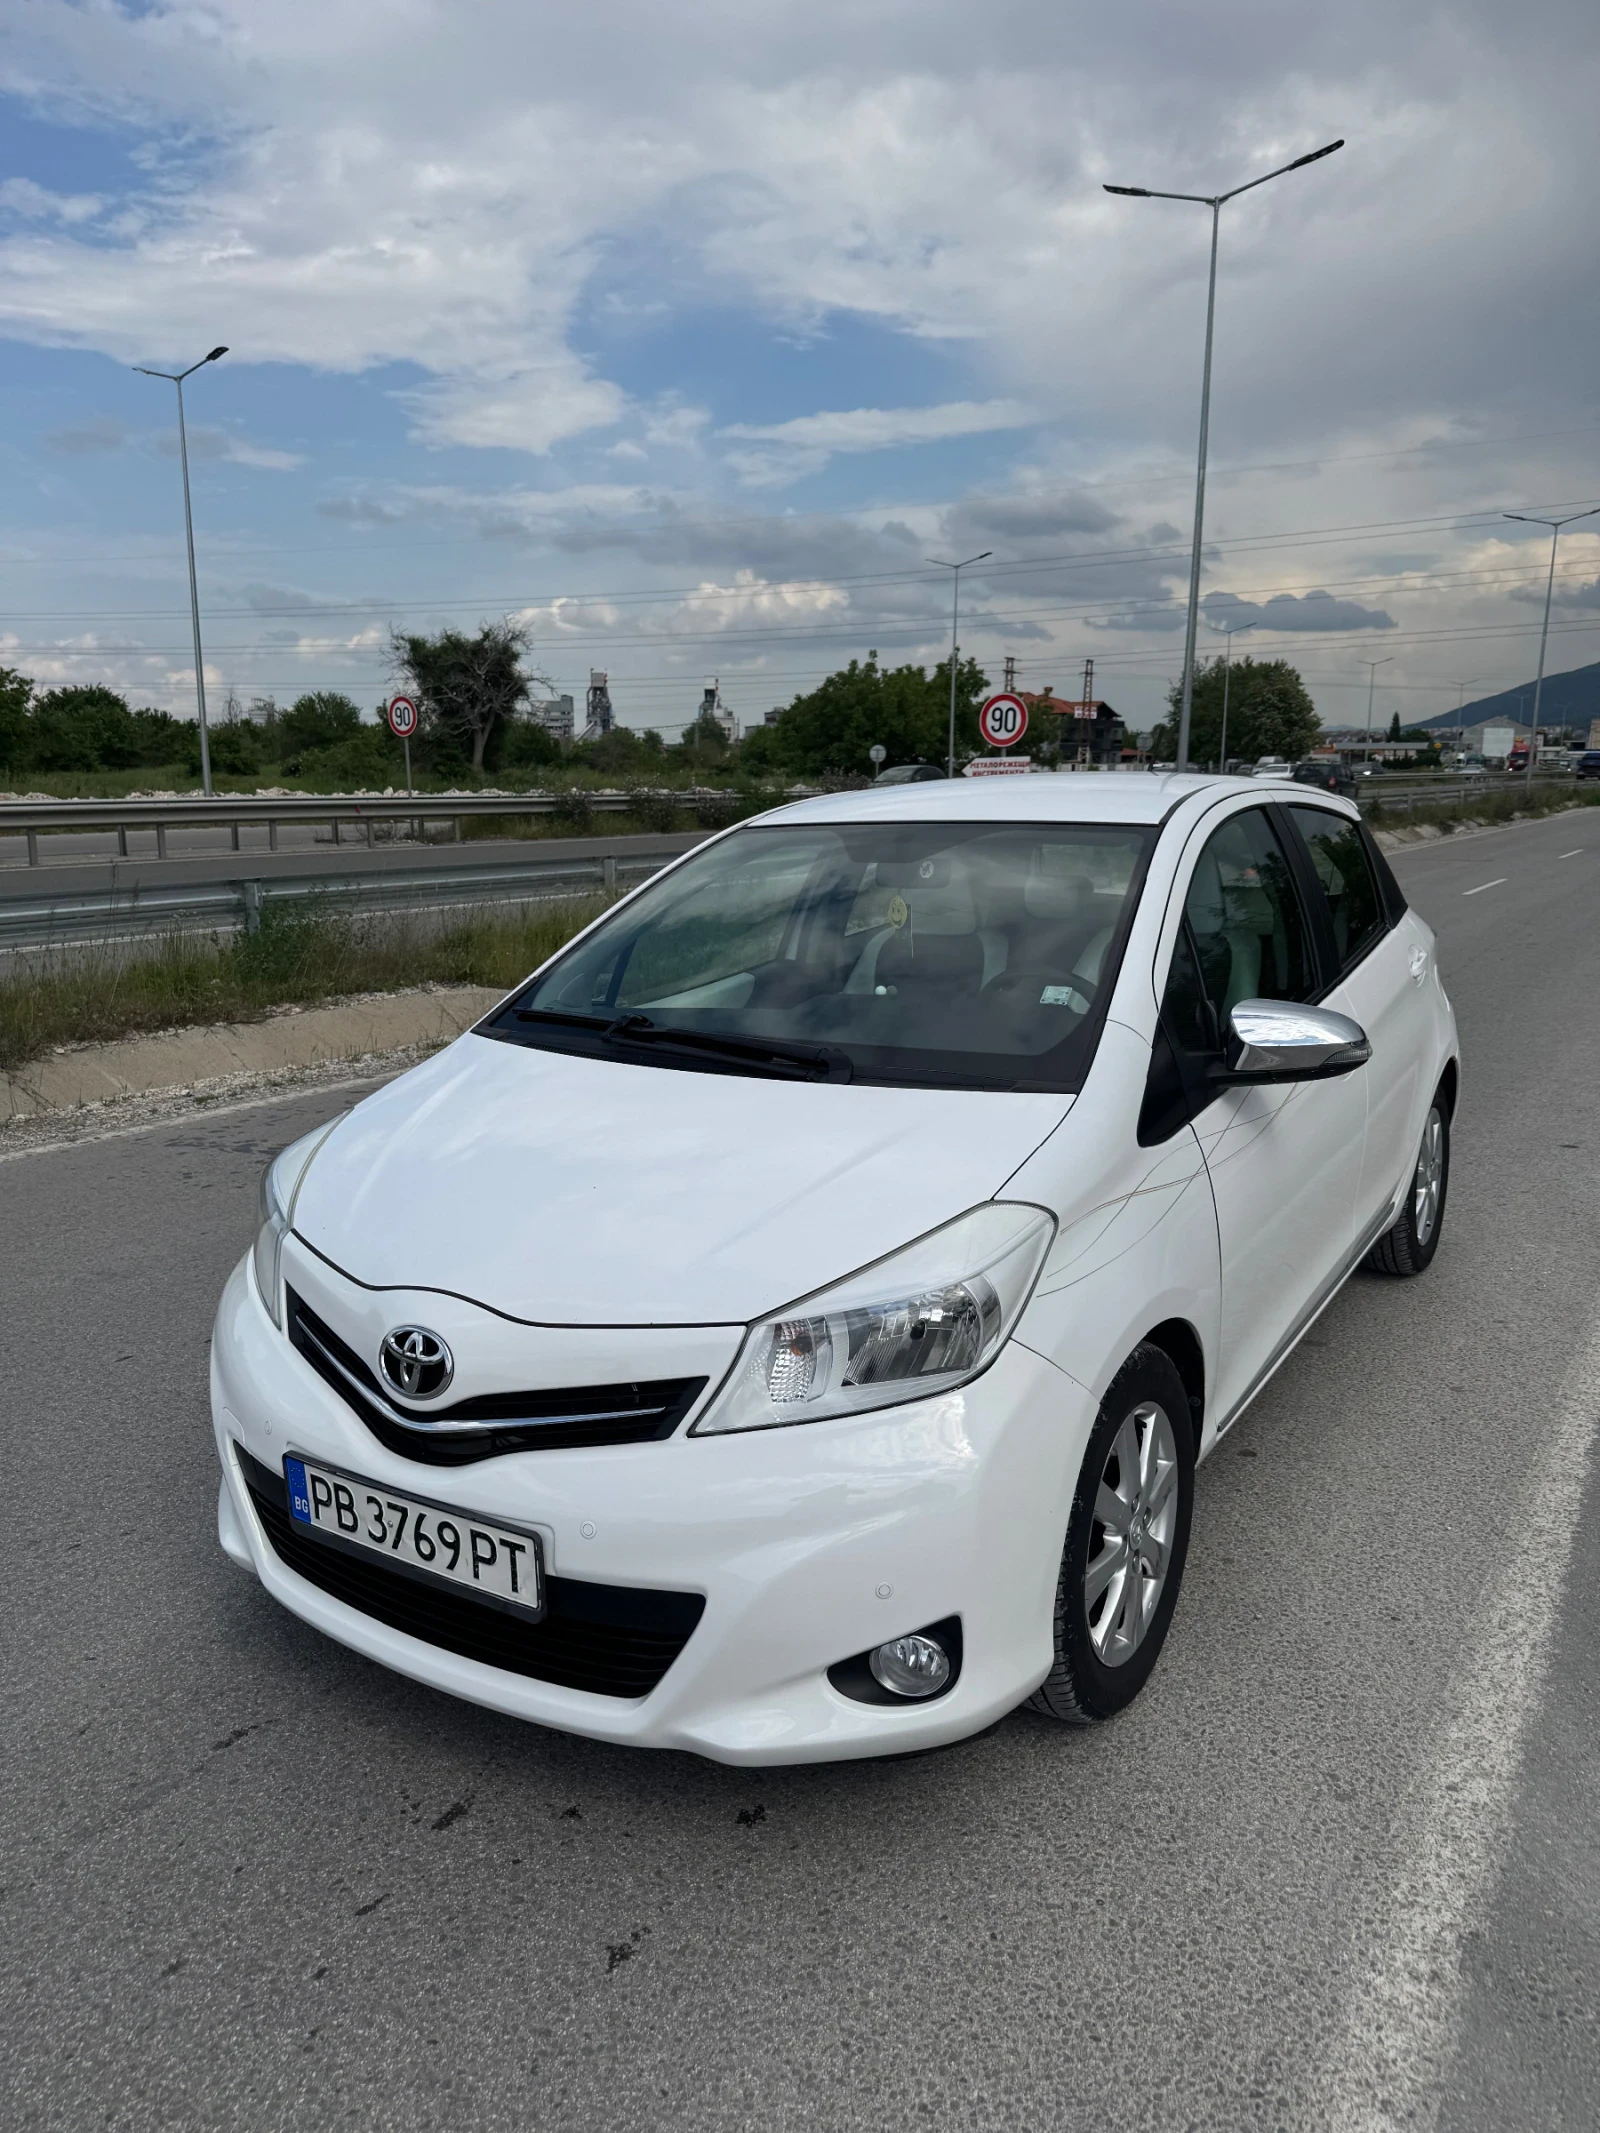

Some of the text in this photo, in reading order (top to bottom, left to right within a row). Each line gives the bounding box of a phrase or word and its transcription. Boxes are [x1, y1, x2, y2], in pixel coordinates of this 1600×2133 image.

[395, 706, 410, 726] 90
[990, 707, 1017, 733] 90
[294, 1495, 309, 1514] BG
